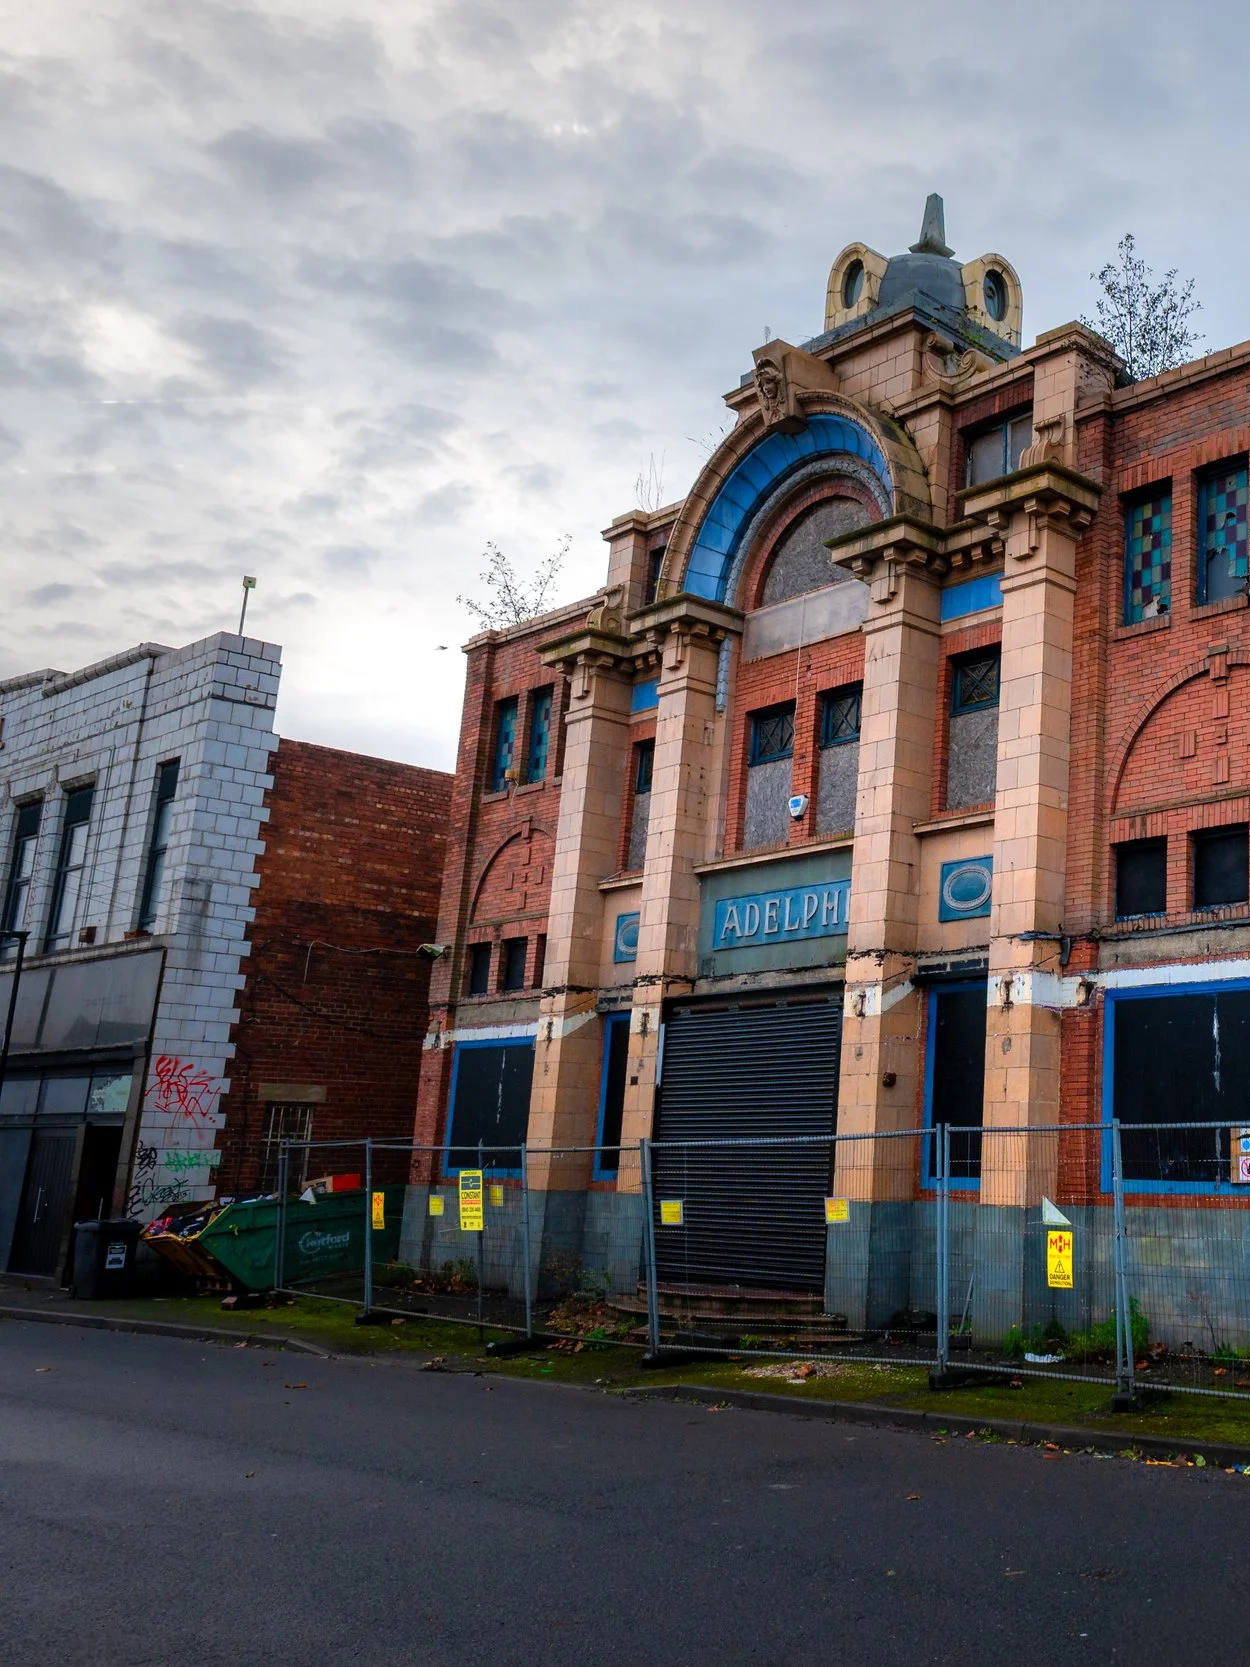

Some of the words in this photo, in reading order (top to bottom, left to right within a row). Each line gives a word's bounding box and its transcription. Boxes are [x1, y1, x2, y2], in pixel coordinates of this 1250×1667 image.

[720, 888, 851, 940] ADELPHI
[461, 1191, 481, 1199] CONSTANT
[1049, 1273, 1070, 1281] DANGER
